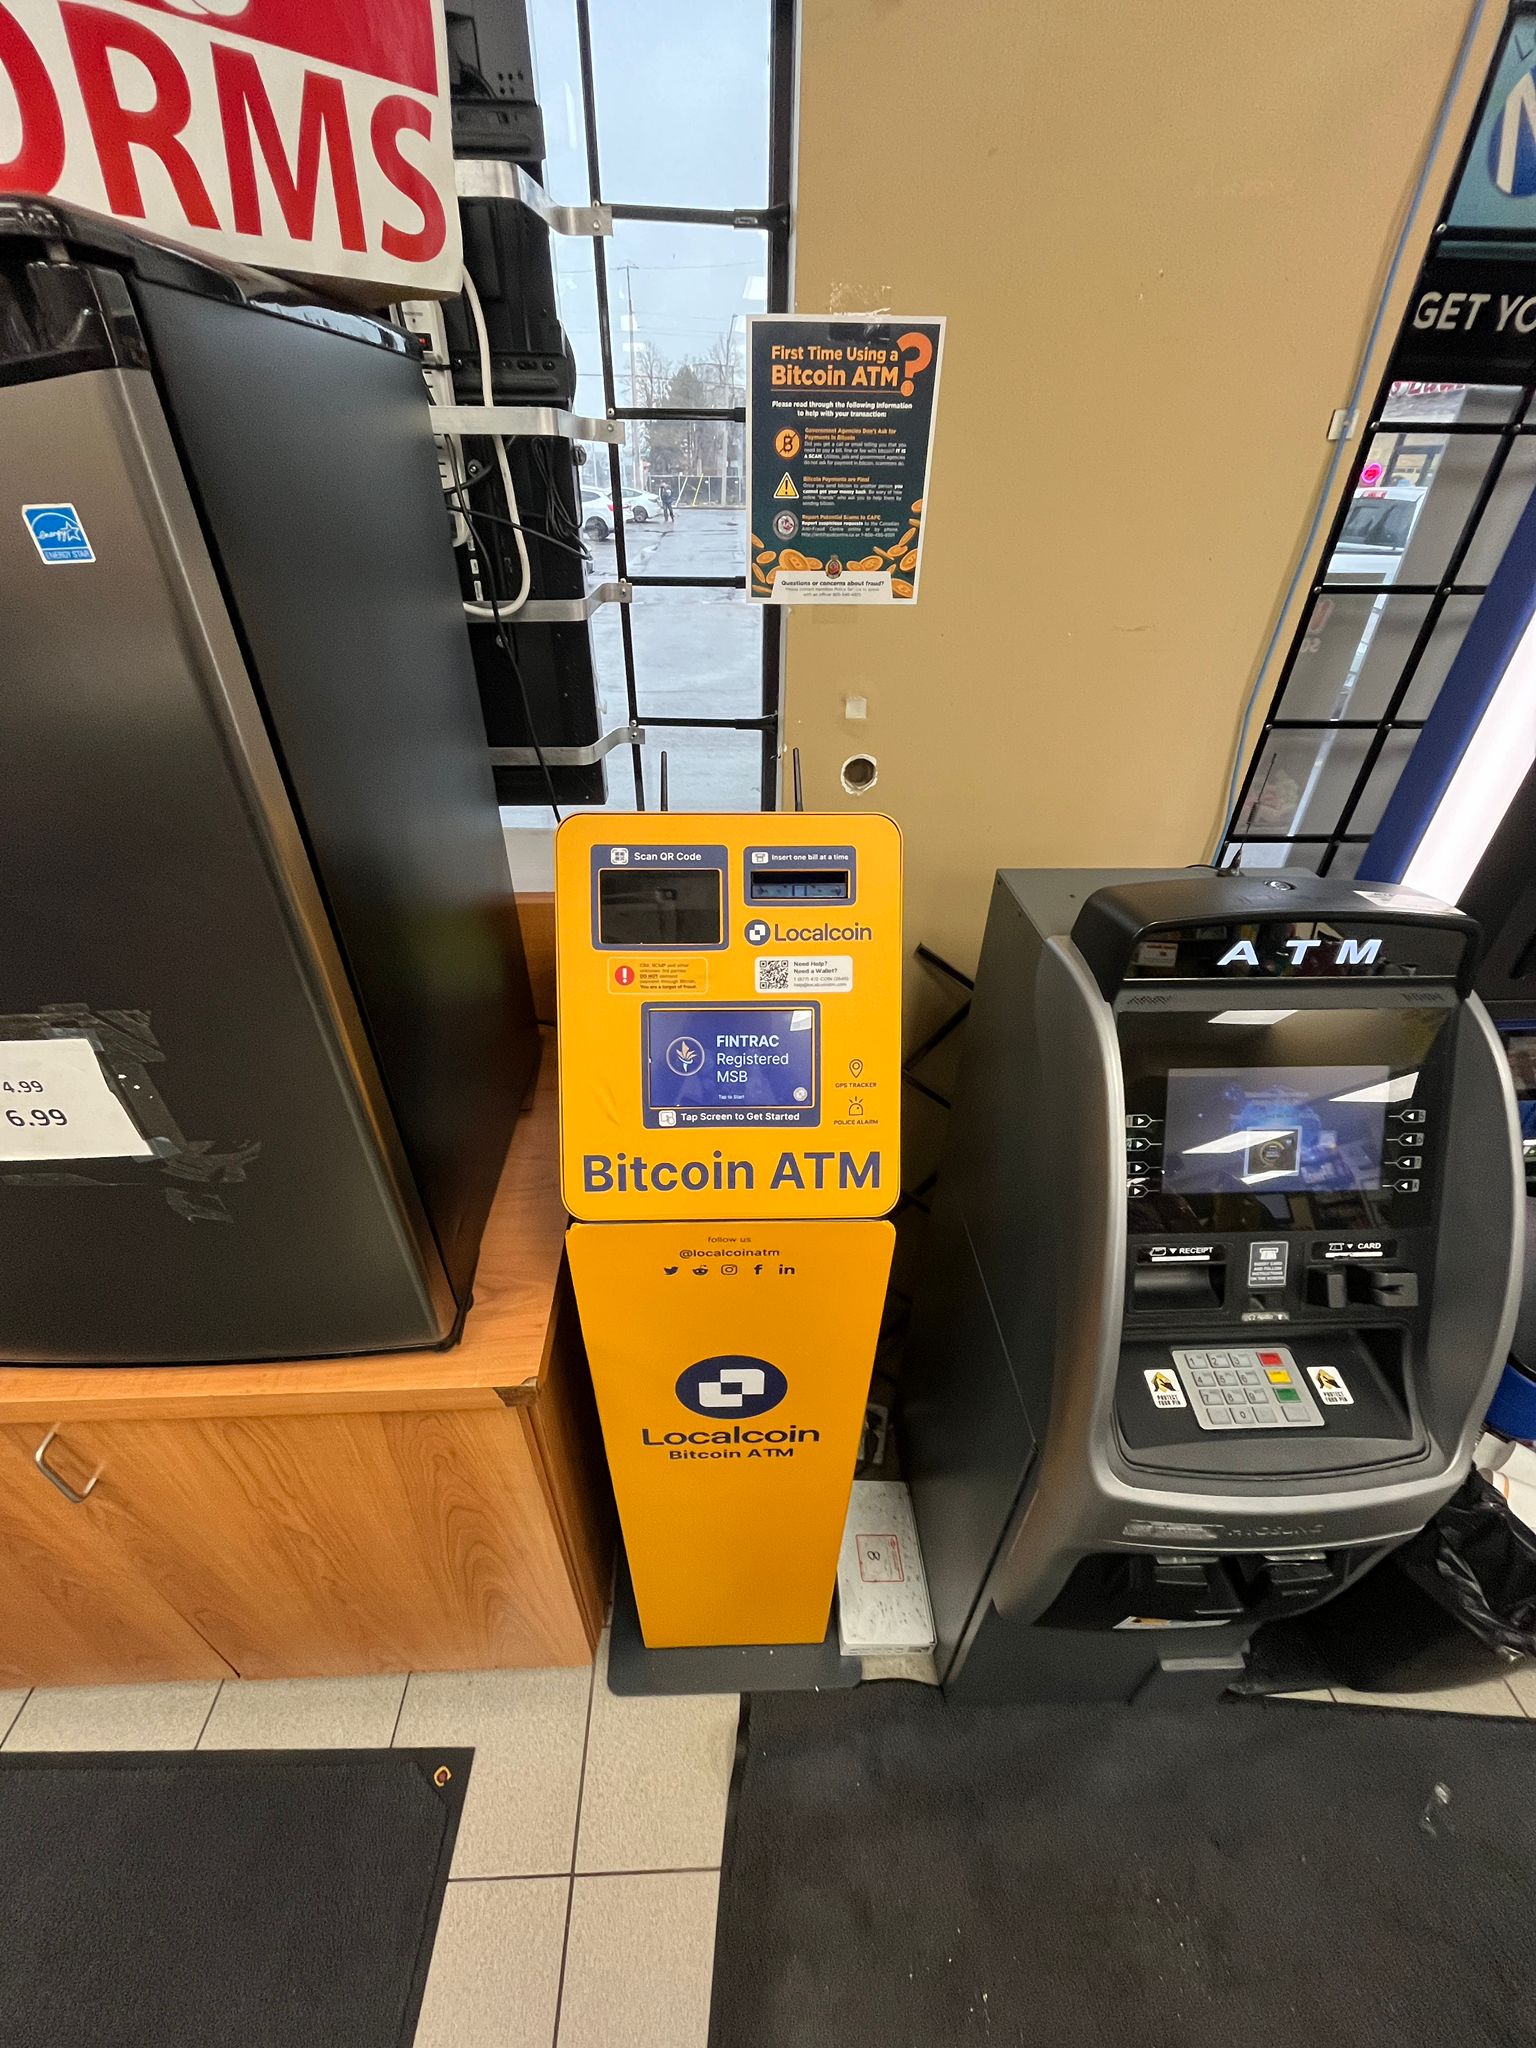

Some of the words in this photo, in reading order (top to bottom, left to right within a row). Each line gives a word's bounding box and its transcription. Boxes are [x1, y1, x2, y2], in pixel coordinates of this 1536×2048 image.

[1412, 291, 1492, 331] GET
[771, 345, 804, 360] First
[808, 346, 842, 361] Time
[846, 346, 886, 363] Using
[890, 352, 898, 362] a
[770, 364, 846, 386] Bitcoin
[852, 366, 898, 387] ATM
[634, 852, 658, 861] Scan
[660, 852, 674, 862] QR
[676, 852, 702, 861] Code
[774, 922, 872, 942] Localcoin
[1216, 938, 1382, 966] ATM
[716, 1035, 780, 1048] FINTRAC
[716, 1052, 789, 1068] Registered
[716, 1071, 748, 1083] MSB
[3, 1080, 44, 1094] 4.99
[6, 1108, 68, 1127] 6.99
[681, 1113, 698, 1123] Tap
[700, 1113, 732, 1121] Screen
[746, 1112, 763, 1121] Get
[765, 1112, 800, 1121] Started
[583, 1150, 754, 1192] Bitcoin
[770, 1151, 880, 1190] ATM
[680, 1248, 780, 1259] @localcoinatm
[1212, 1357, 1218, 1365] 2
[1234, 1357, 1240, 1365] 3
[642, 1426, 820, 1446] Localcoin
[669, 1449, 742, 1460] Bitcoin
[747, 1448, 794, 1458] ATM
